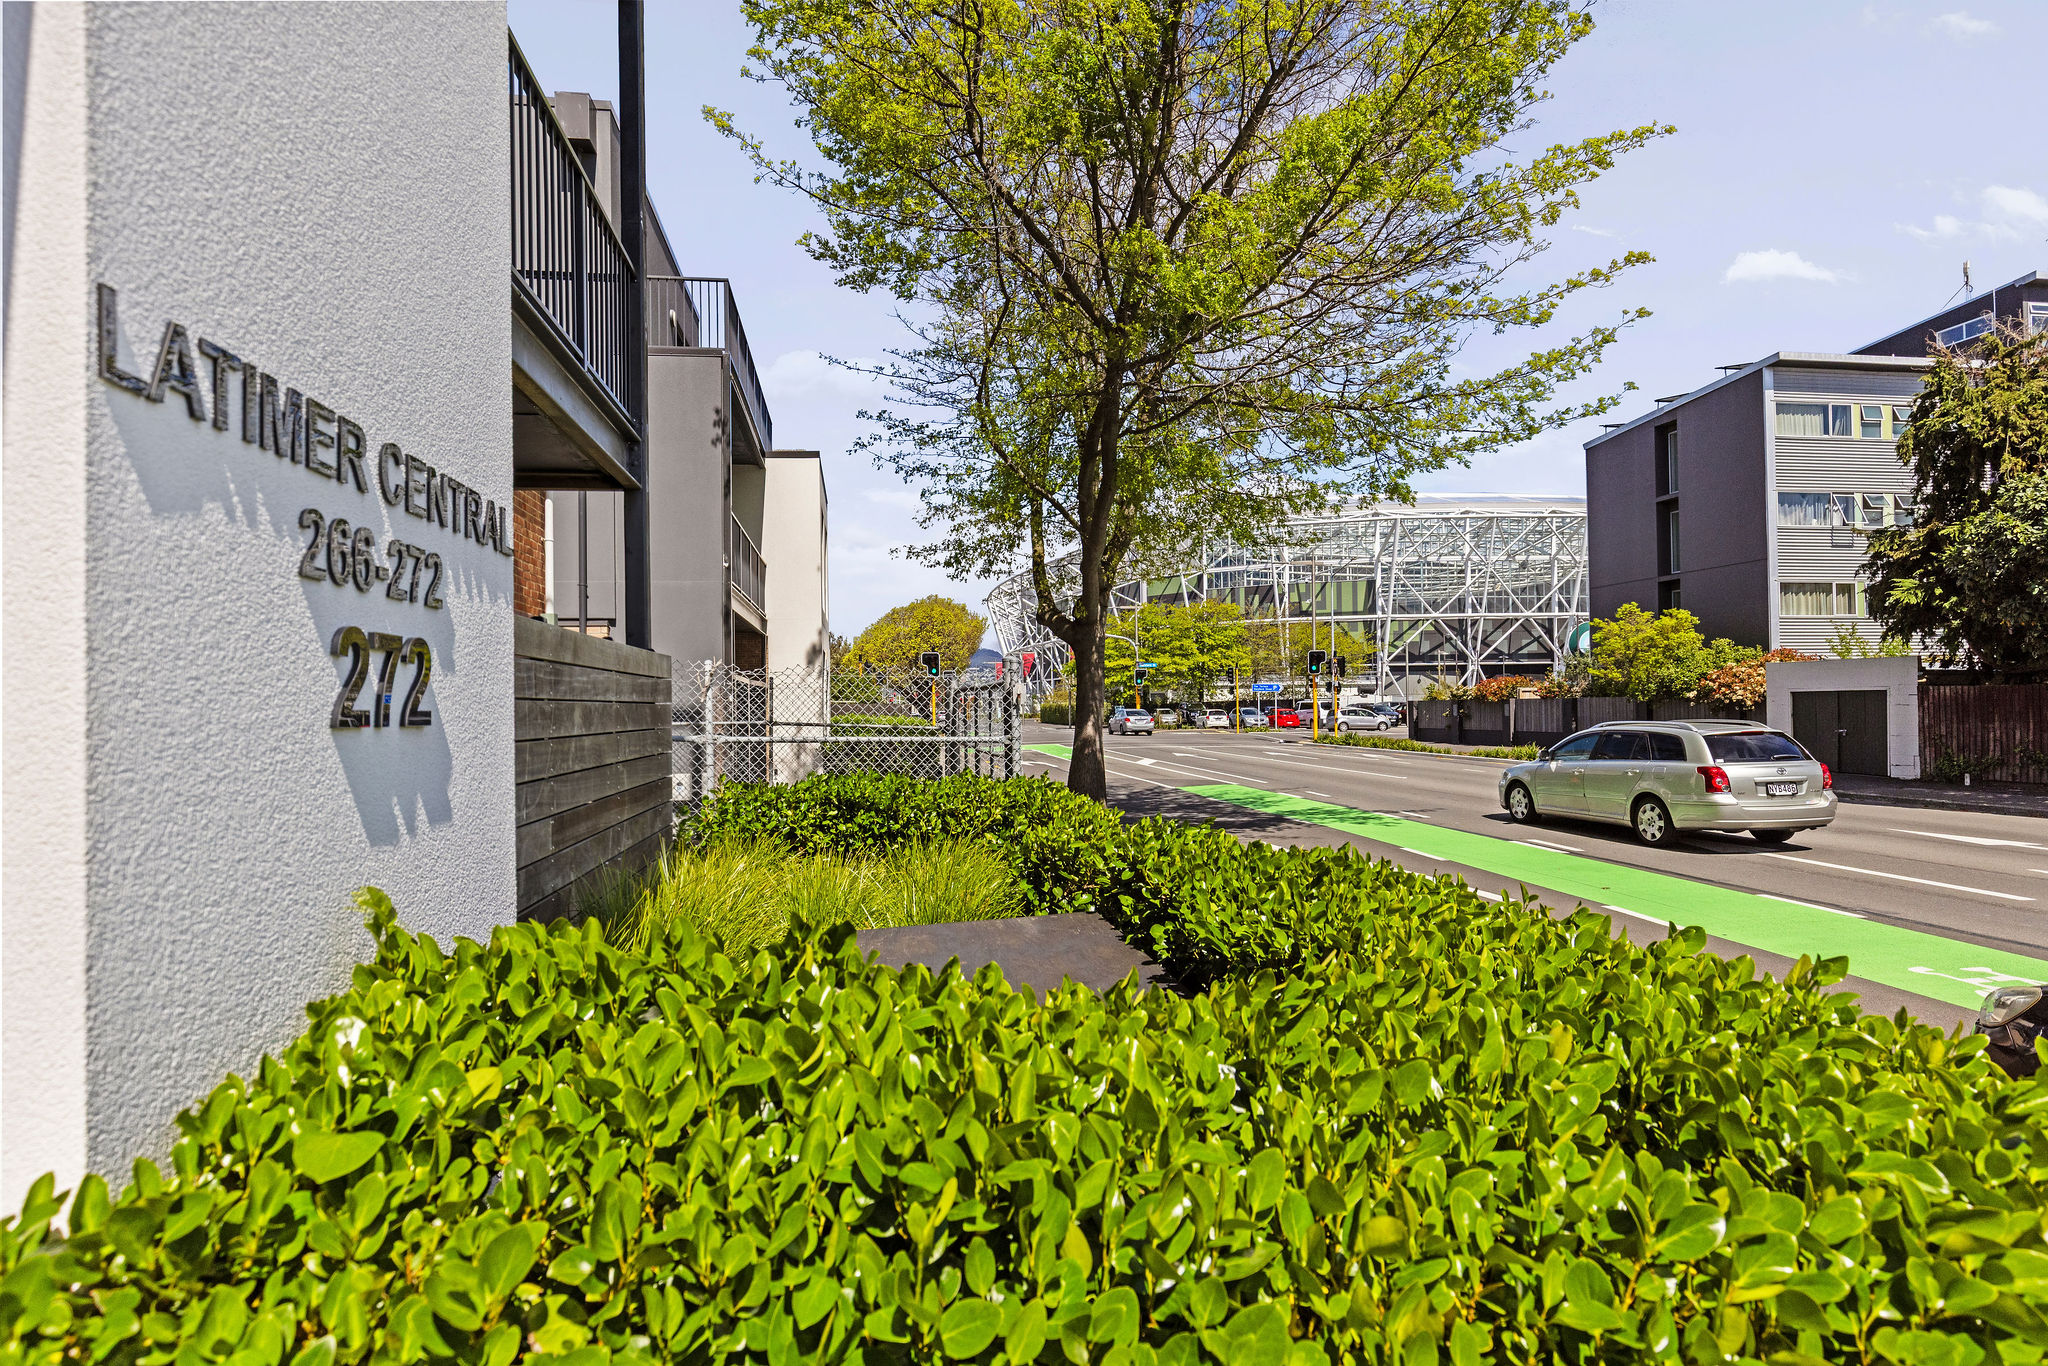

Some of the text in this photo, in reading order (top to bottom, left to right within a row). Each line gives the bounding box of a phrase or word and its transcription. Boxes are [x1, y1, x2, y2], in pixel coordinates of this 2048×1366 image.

[97, 282, 514, 556] LATIMER CENTRAL
[298, 508, 443, 609] 266-272
[330, 626, 432, 729] 272
